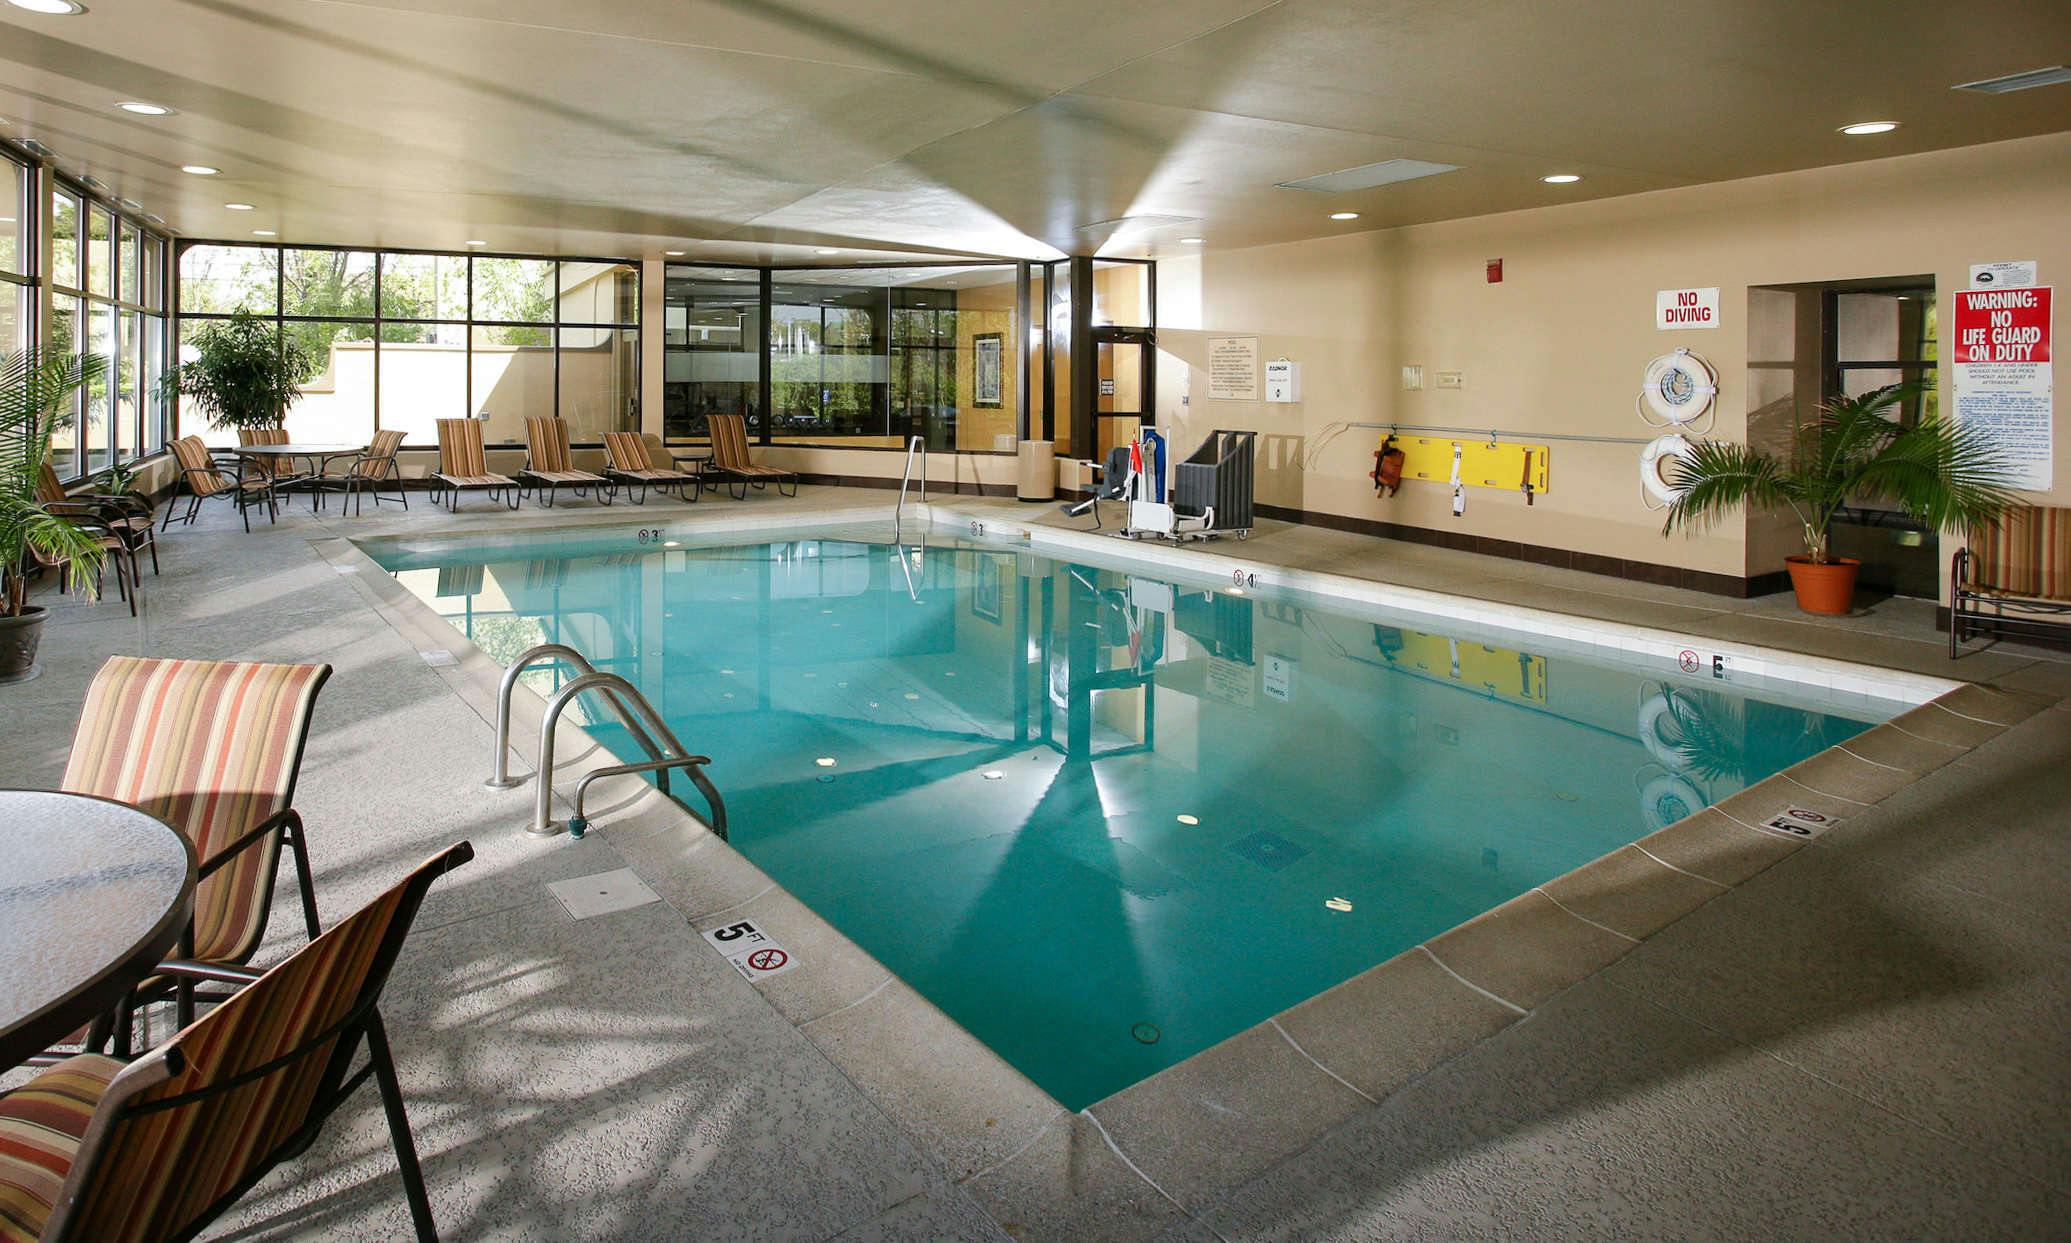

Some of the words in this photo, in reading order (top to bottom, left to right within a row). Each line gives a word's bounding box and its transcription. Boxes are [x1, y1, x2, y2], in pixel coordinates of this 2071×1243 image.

[1678, 292, 1698, 307] NO
[1967, 291, 2038, 310] WARNING:
[1665, 307, 1711, 323] DIVING
[1991, 310, 2012, 328] NO
[1962, 328, 1987, 345] LIFE
[1991, 326, 2041, 344] GUARD
[1969, 345, 1990, 361] ON
[1995, 343, 2034, 361] DUTY
[1770, 820, 1811, 835] 5
[714, 921, 756, 941] 5
[747, 932, 766, 943] FT
